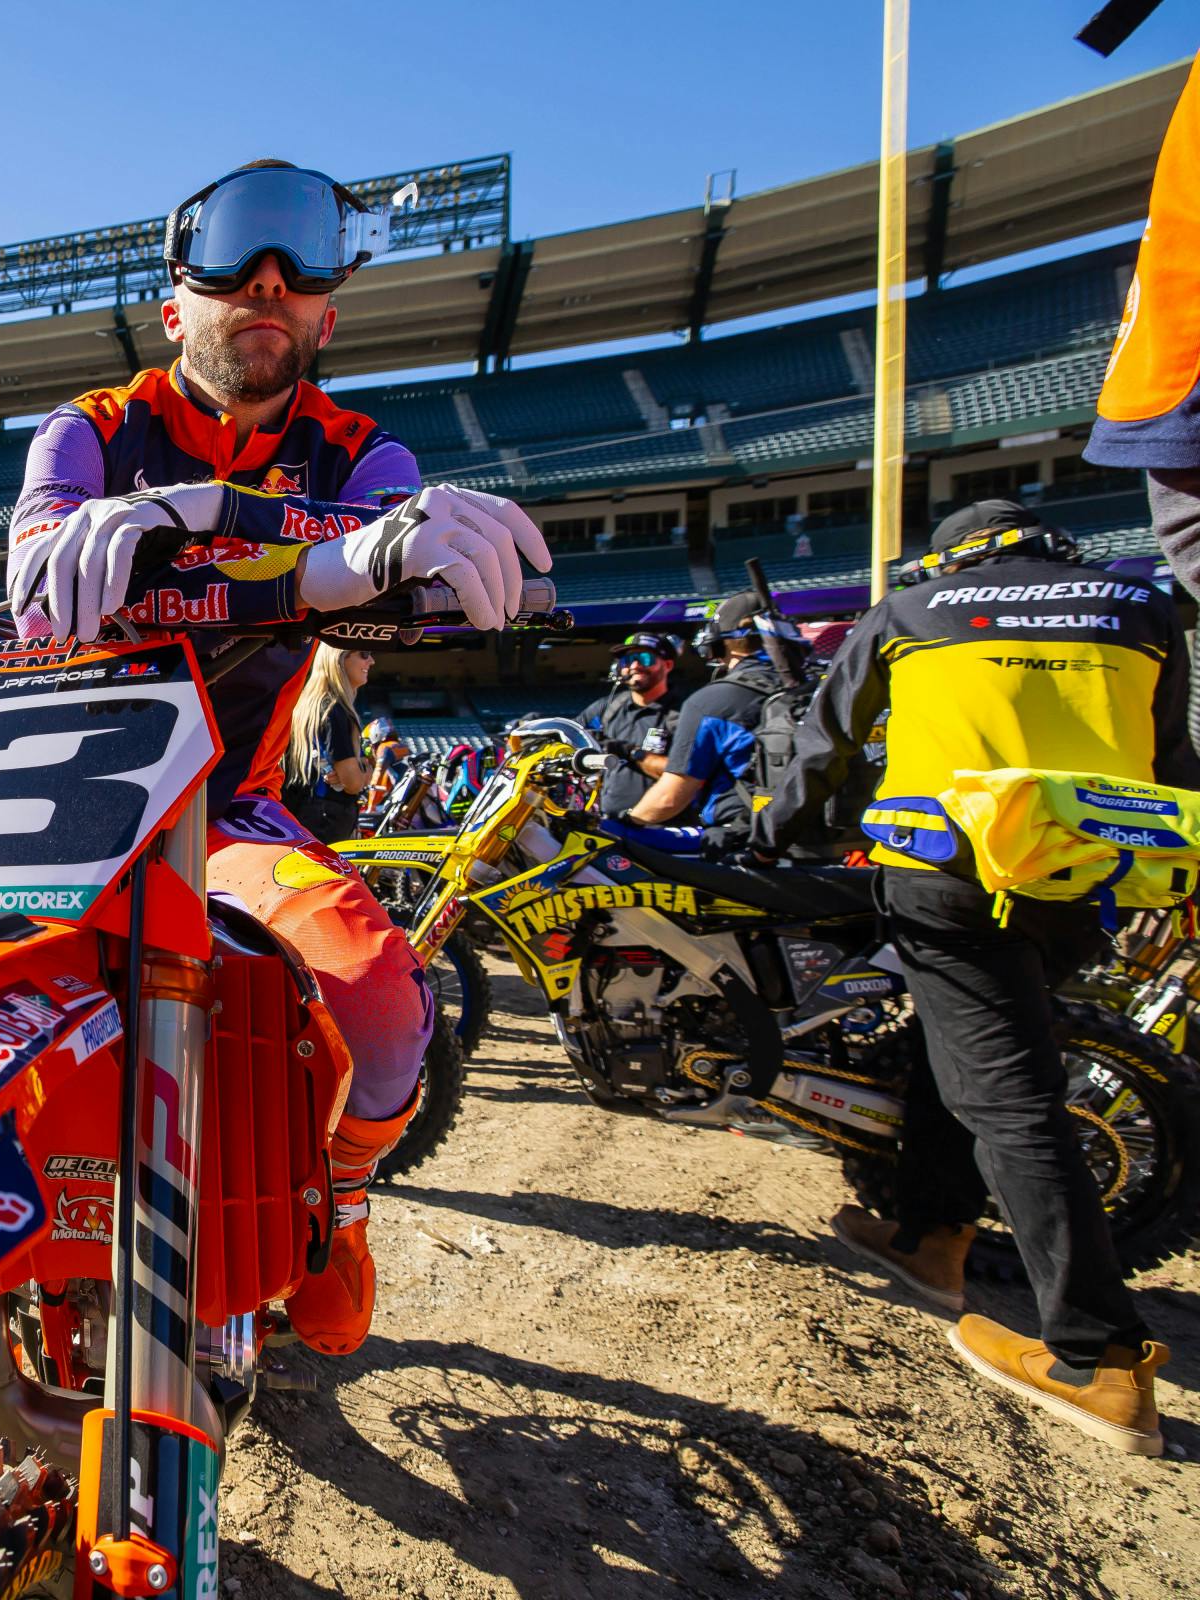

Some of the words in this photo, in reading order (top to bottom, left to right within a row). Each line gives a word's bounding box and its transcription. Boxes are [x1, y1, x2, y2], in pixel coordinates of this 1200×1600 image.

[280, 503, 341, 542] Red
[159, 583, 229, 624] Bull
[927, 581, 1150, 609] PROGRESSIVE
[320, 622, 398, 641] ARC
[996, 615, 1120, 630] SUZUKI
[1006, 657, 1068, 671] PMG
[1099, 783, 1158, 796] SUZUKI
[1085, 793, 1165, 811] PROGRESSIVE
[374, 850, 443, 863] PROGRESSIVE
[508, 885, 636, 942] TWISTED
[632, 882, 698, 916] TEA
[1077, 1039, 1169, 1083] DUNLOP
